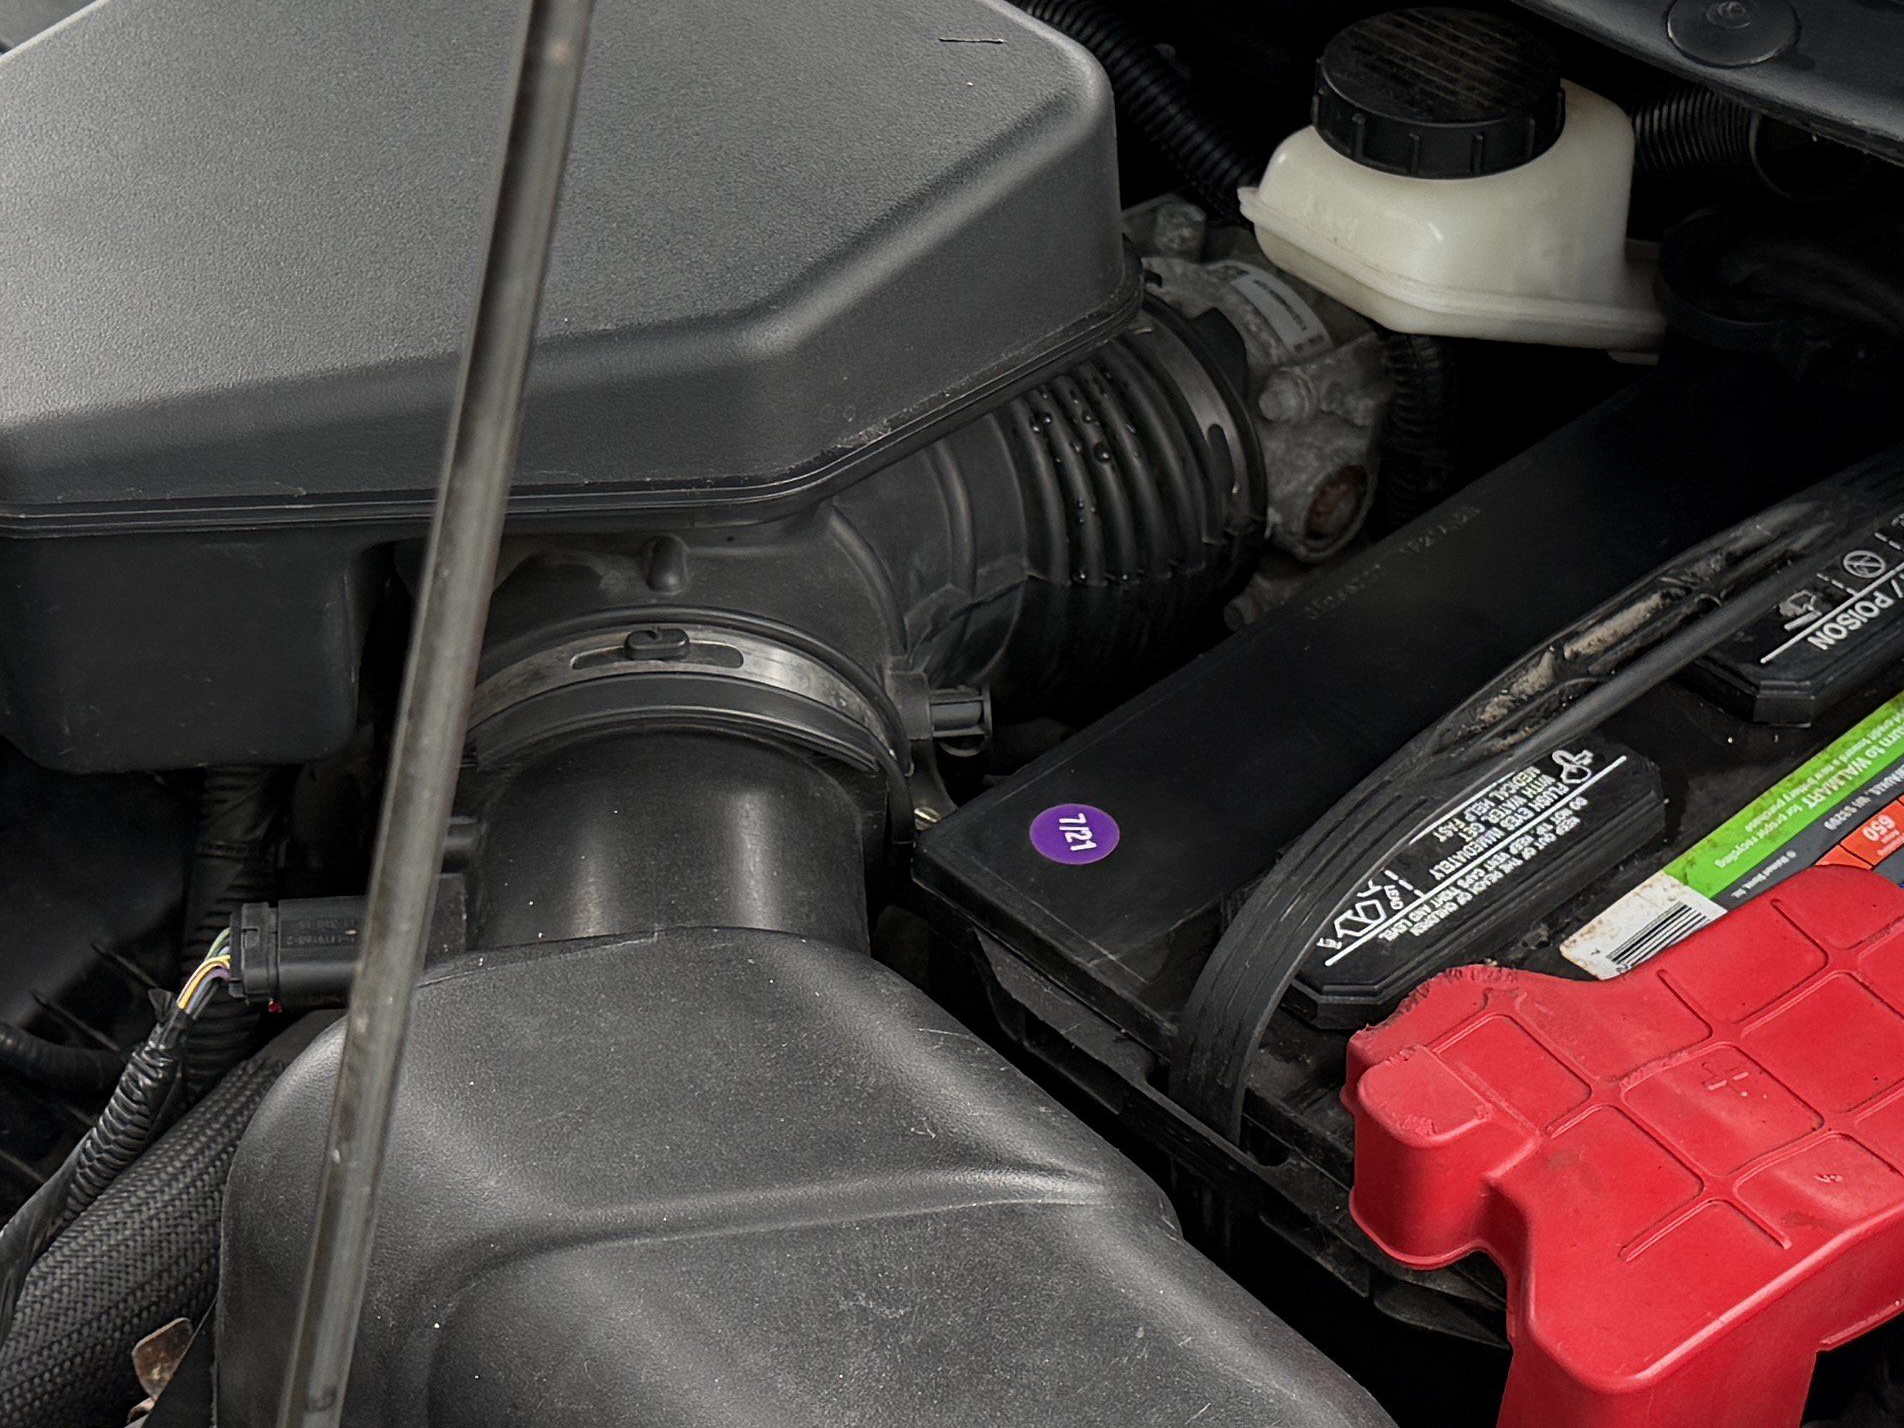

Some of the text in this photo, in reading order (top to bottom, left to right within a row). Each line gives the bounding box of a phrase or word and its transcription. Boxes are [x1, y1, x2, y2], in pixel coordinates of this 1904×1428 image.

[1808, 593, 1892, 649] POISON
[1864, 742, 1885, 758] to
[1521, 774, 1555, 801] WITH
[1801, 756, 1871, 808] WALMART
[1433, 766, 1540, 841] MEDICAL HELP FAST
[1058, 812, 1098, 851] 7/21
[1430, 779, 1568, 879] FLUSH EYES IMMEDIATELY
[1458, 822, 1485, 841] GET
[1862, 815, 1894, 840] 650
[1714, 836, 1758, 867] recycling
